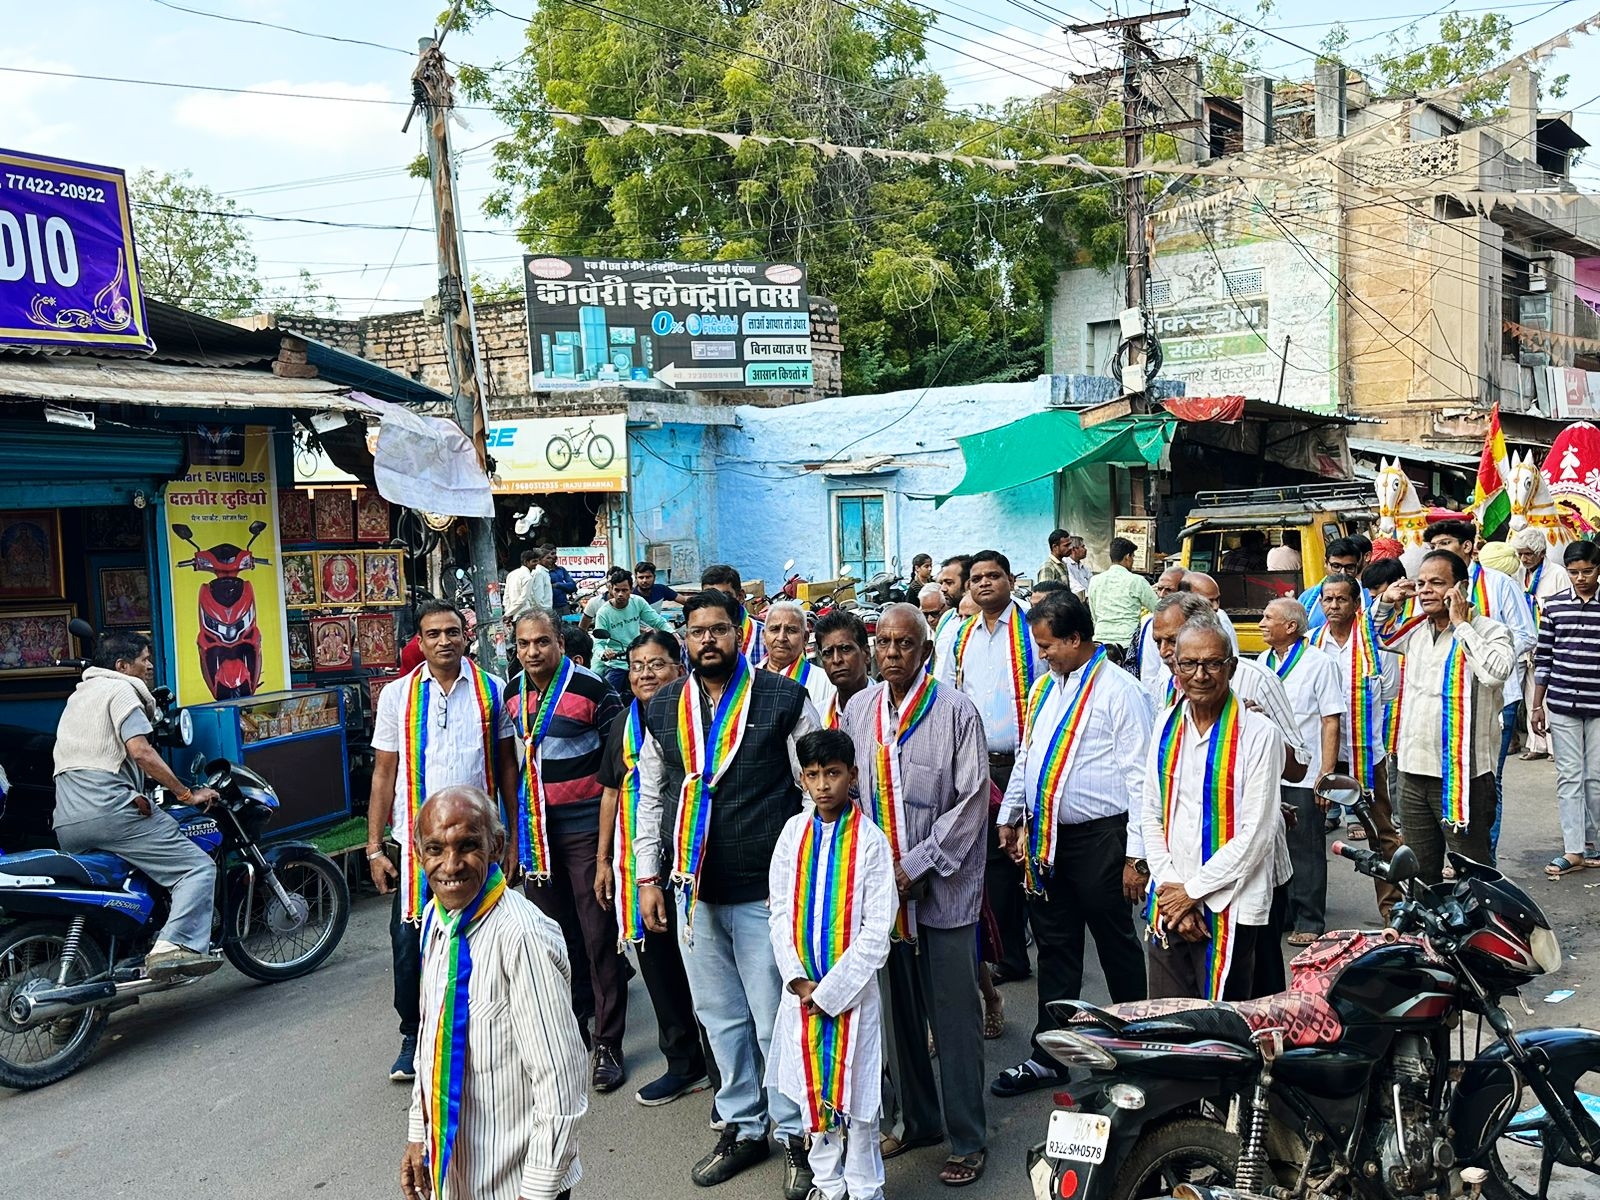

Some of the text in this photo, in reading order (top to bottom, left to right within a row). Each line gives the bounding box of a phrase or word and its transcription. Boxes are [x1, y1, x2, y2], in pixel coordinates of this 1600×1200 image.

[5, 173, 105, 203] 77422-20922
[534, 273, 801, 312] कावेरी इलेक्ट्रॉनिक्स
[702, 315, 738, 324] BAJAJ
[703, 325, 738, 335] FINSERV
[750, 341, 770, 355] बिना
[796, 344, 807, 355] पर
[752, 369, 777, 381] आसान
[205, 471, 266, 483] E-VEHICLES
[169, 488, 267, 509] दलवीर स्टुडियो
[583, 553, 605, 565] कम्पनी
[185, 828, 219, 837] HONDA
